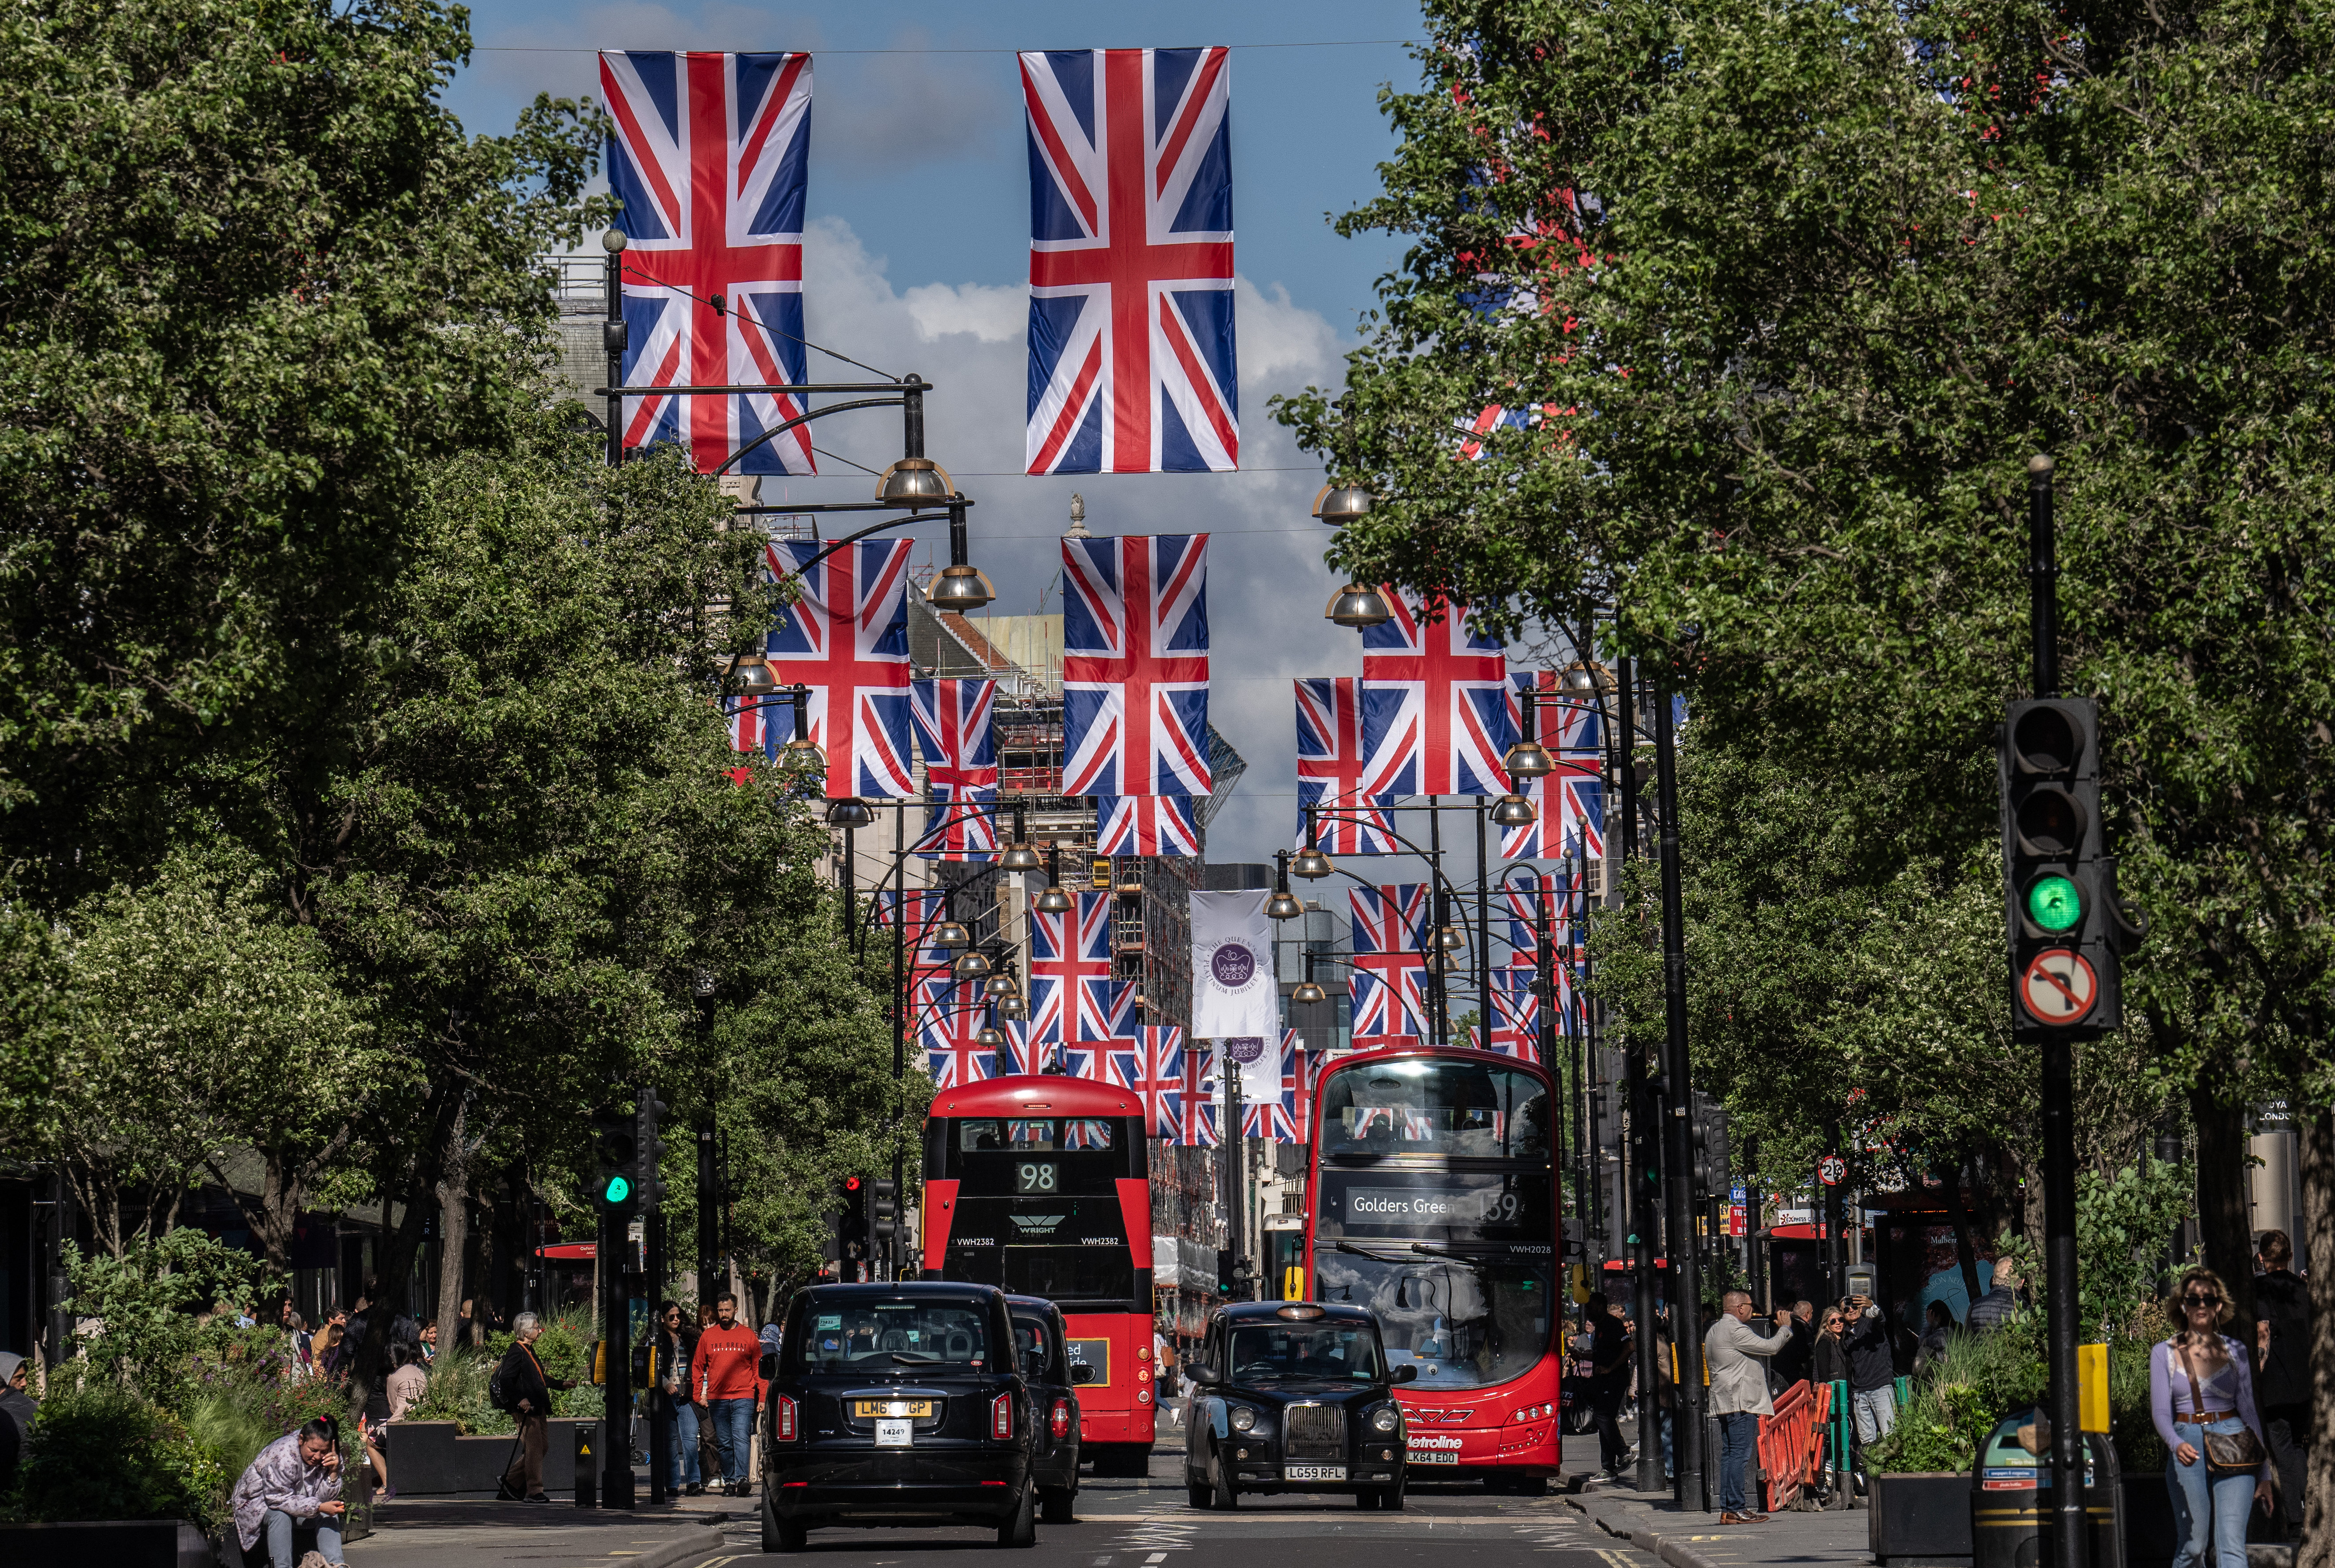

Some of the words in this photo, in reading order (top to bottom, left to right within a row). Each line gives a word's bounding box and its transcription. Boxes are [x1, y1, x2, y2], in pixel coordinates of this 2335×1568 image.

[1208, 939, 1223, 952] THE
[1225, 936, 1257, 952] QUEEN'S
[1204, 960, 1227, 994] PLATINUM
[1231, 976, 1258, 996] JUBILEE
[1243, 1054, 1267, 1071] JUBILEE
[1021, 1164, 1054, 1189] 98
[1354, 1197, 1408, 1212] Golders
[1413, 1198, 1455, 1214] Green
[1480, 1194, 1517, 1221] 139
[1510, 1245, 1551, 1254] VWH2028
[1922, 1276, 1946, 1300] CARBON
[1407, 1452, 1432, 1462] LK64
[1436, 1453, 1454, 1463] EDO
[1290, 1468, 1318, 1478] LG59
[1321, 1468, 1342, 1478] RFL
